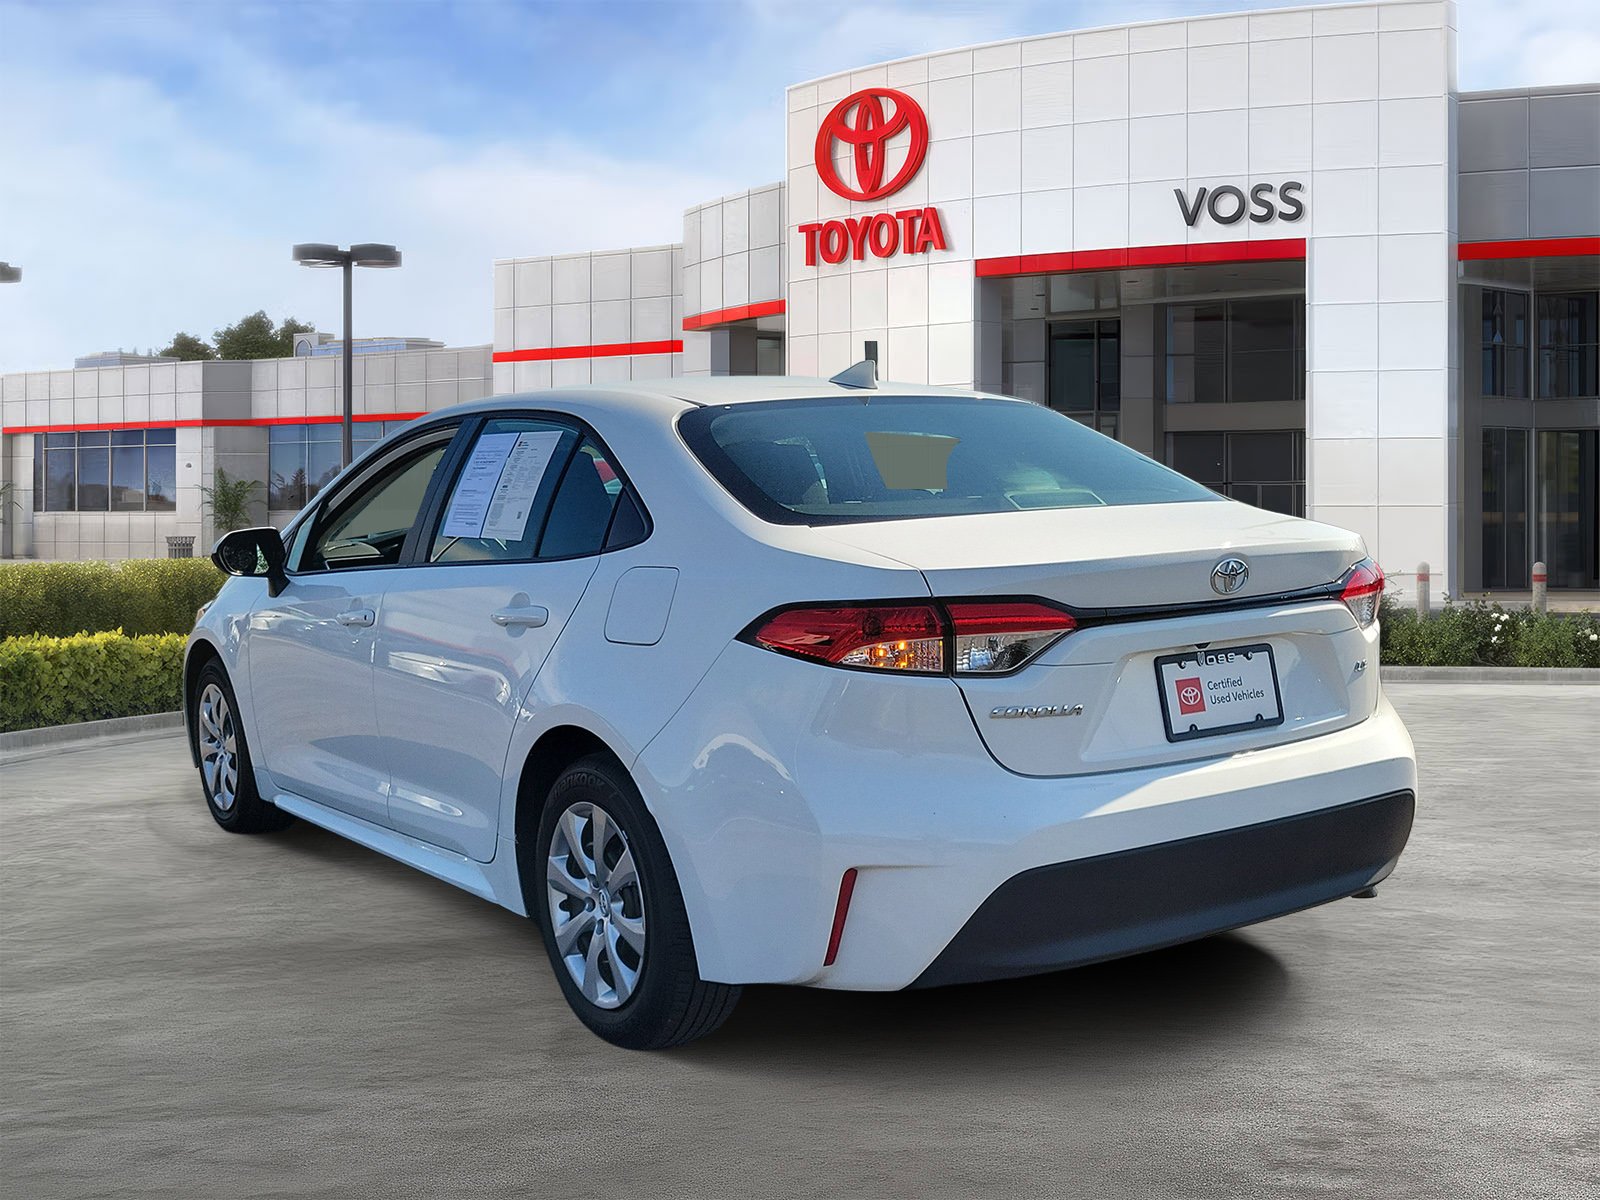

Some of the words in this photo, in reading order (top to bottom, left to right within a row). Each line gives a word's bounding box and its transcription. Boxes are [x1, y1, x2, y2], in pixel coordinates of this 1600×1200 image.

[1173, 181, 1303, 226] VOSS
[798, 207, 947, 266] TOYOTA
[1207, 676, 1243, 691] Certified
[1210, 692, 1231, 705] Used
[1232, 688, 1265, 702] Vehicles
[990, 703, 1084, 719] COROLLA
